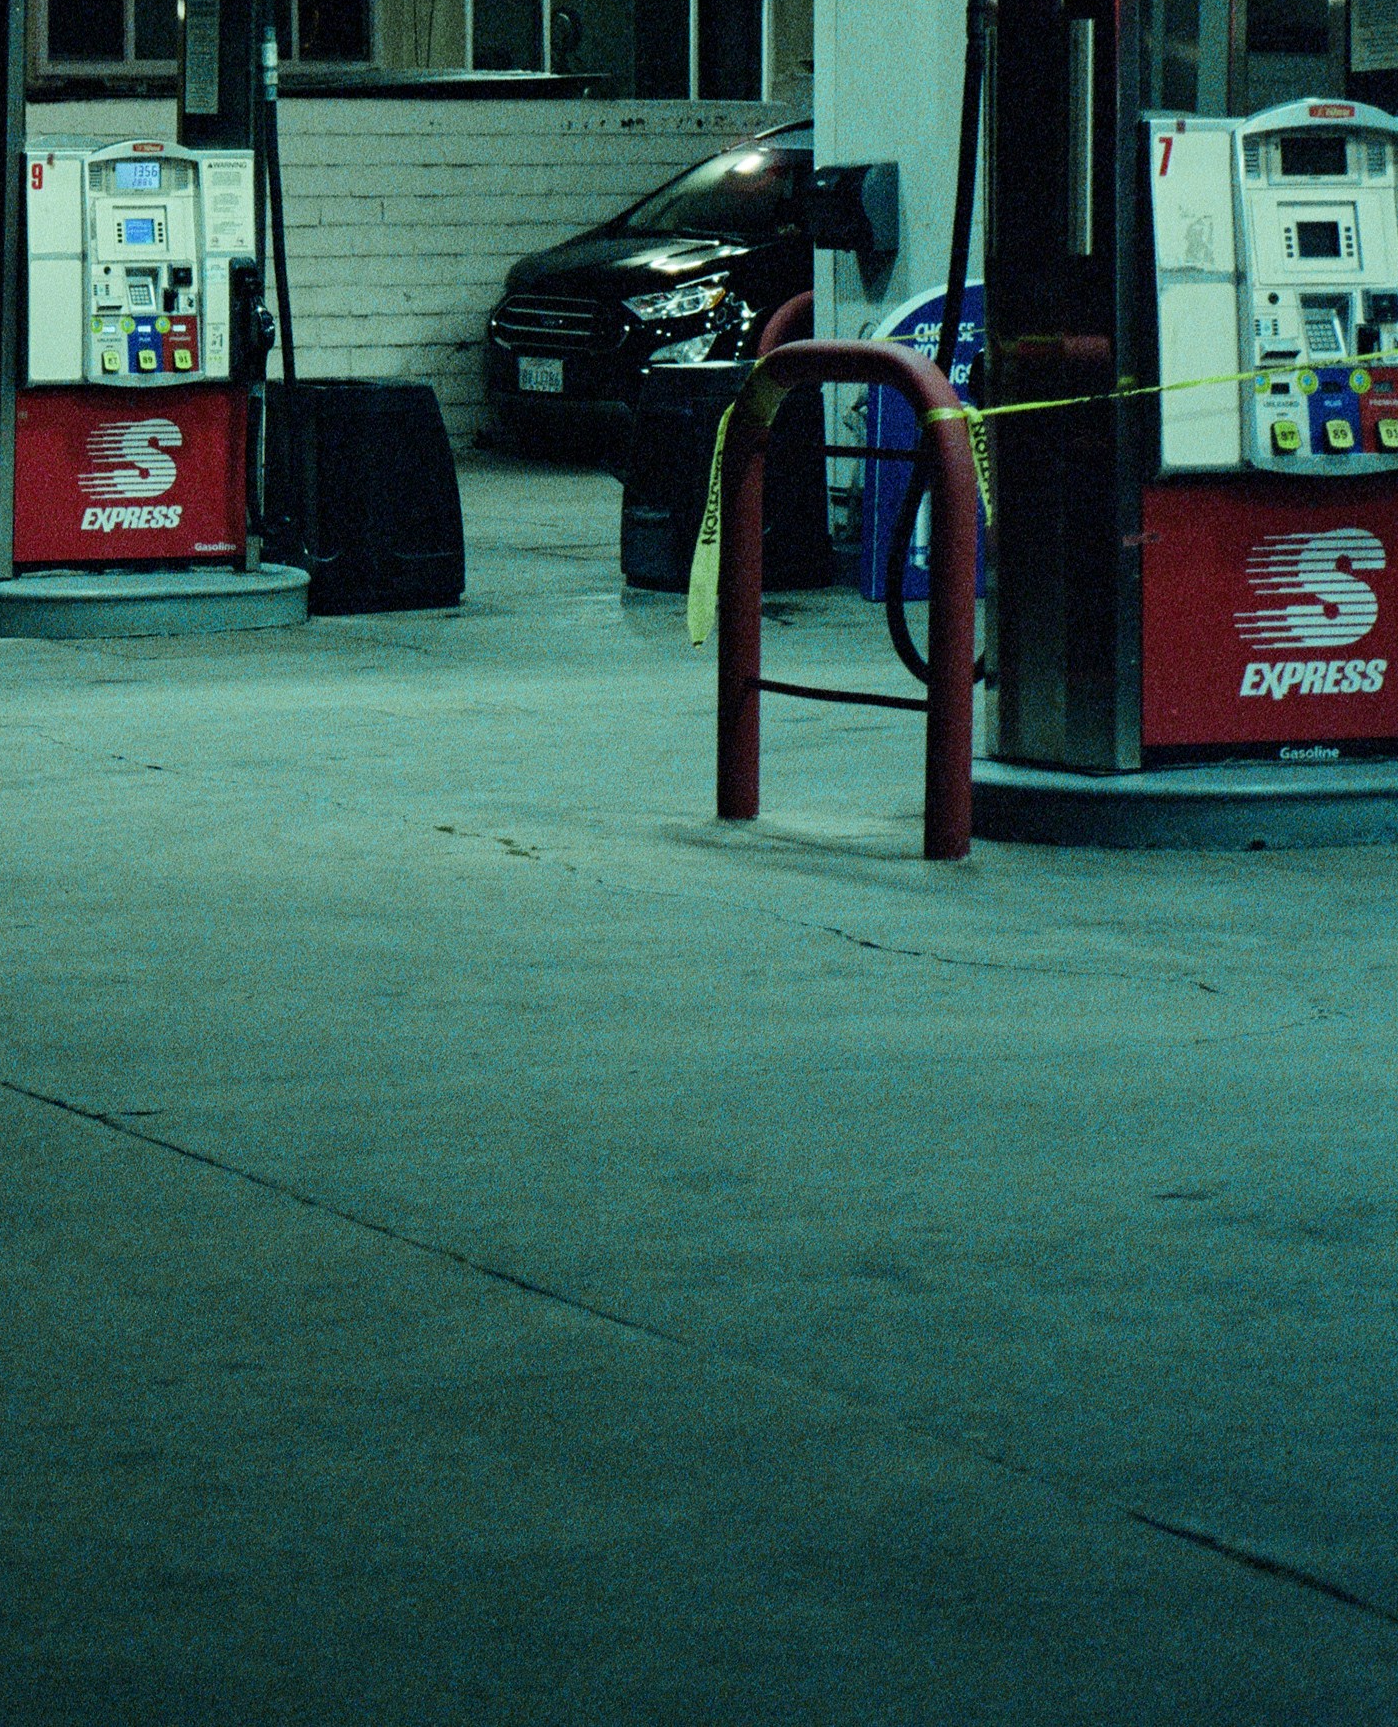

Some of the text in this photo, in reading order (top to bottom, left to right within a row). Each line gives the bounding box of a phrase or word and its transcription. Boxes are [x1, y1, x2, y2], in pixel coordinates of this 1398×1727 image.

[213, 161, 247, 169] WARNING
[1158, 136, 1174, 177] 7
[31, 163, 44, 191] 9
[81, 505, 183, 533] EXPRESS
[194, 541, 237, 552] Gasoline
[1240, 658, 1388, 700] EXPRESS
[1279, 745, 1340, 760] Gasoline
